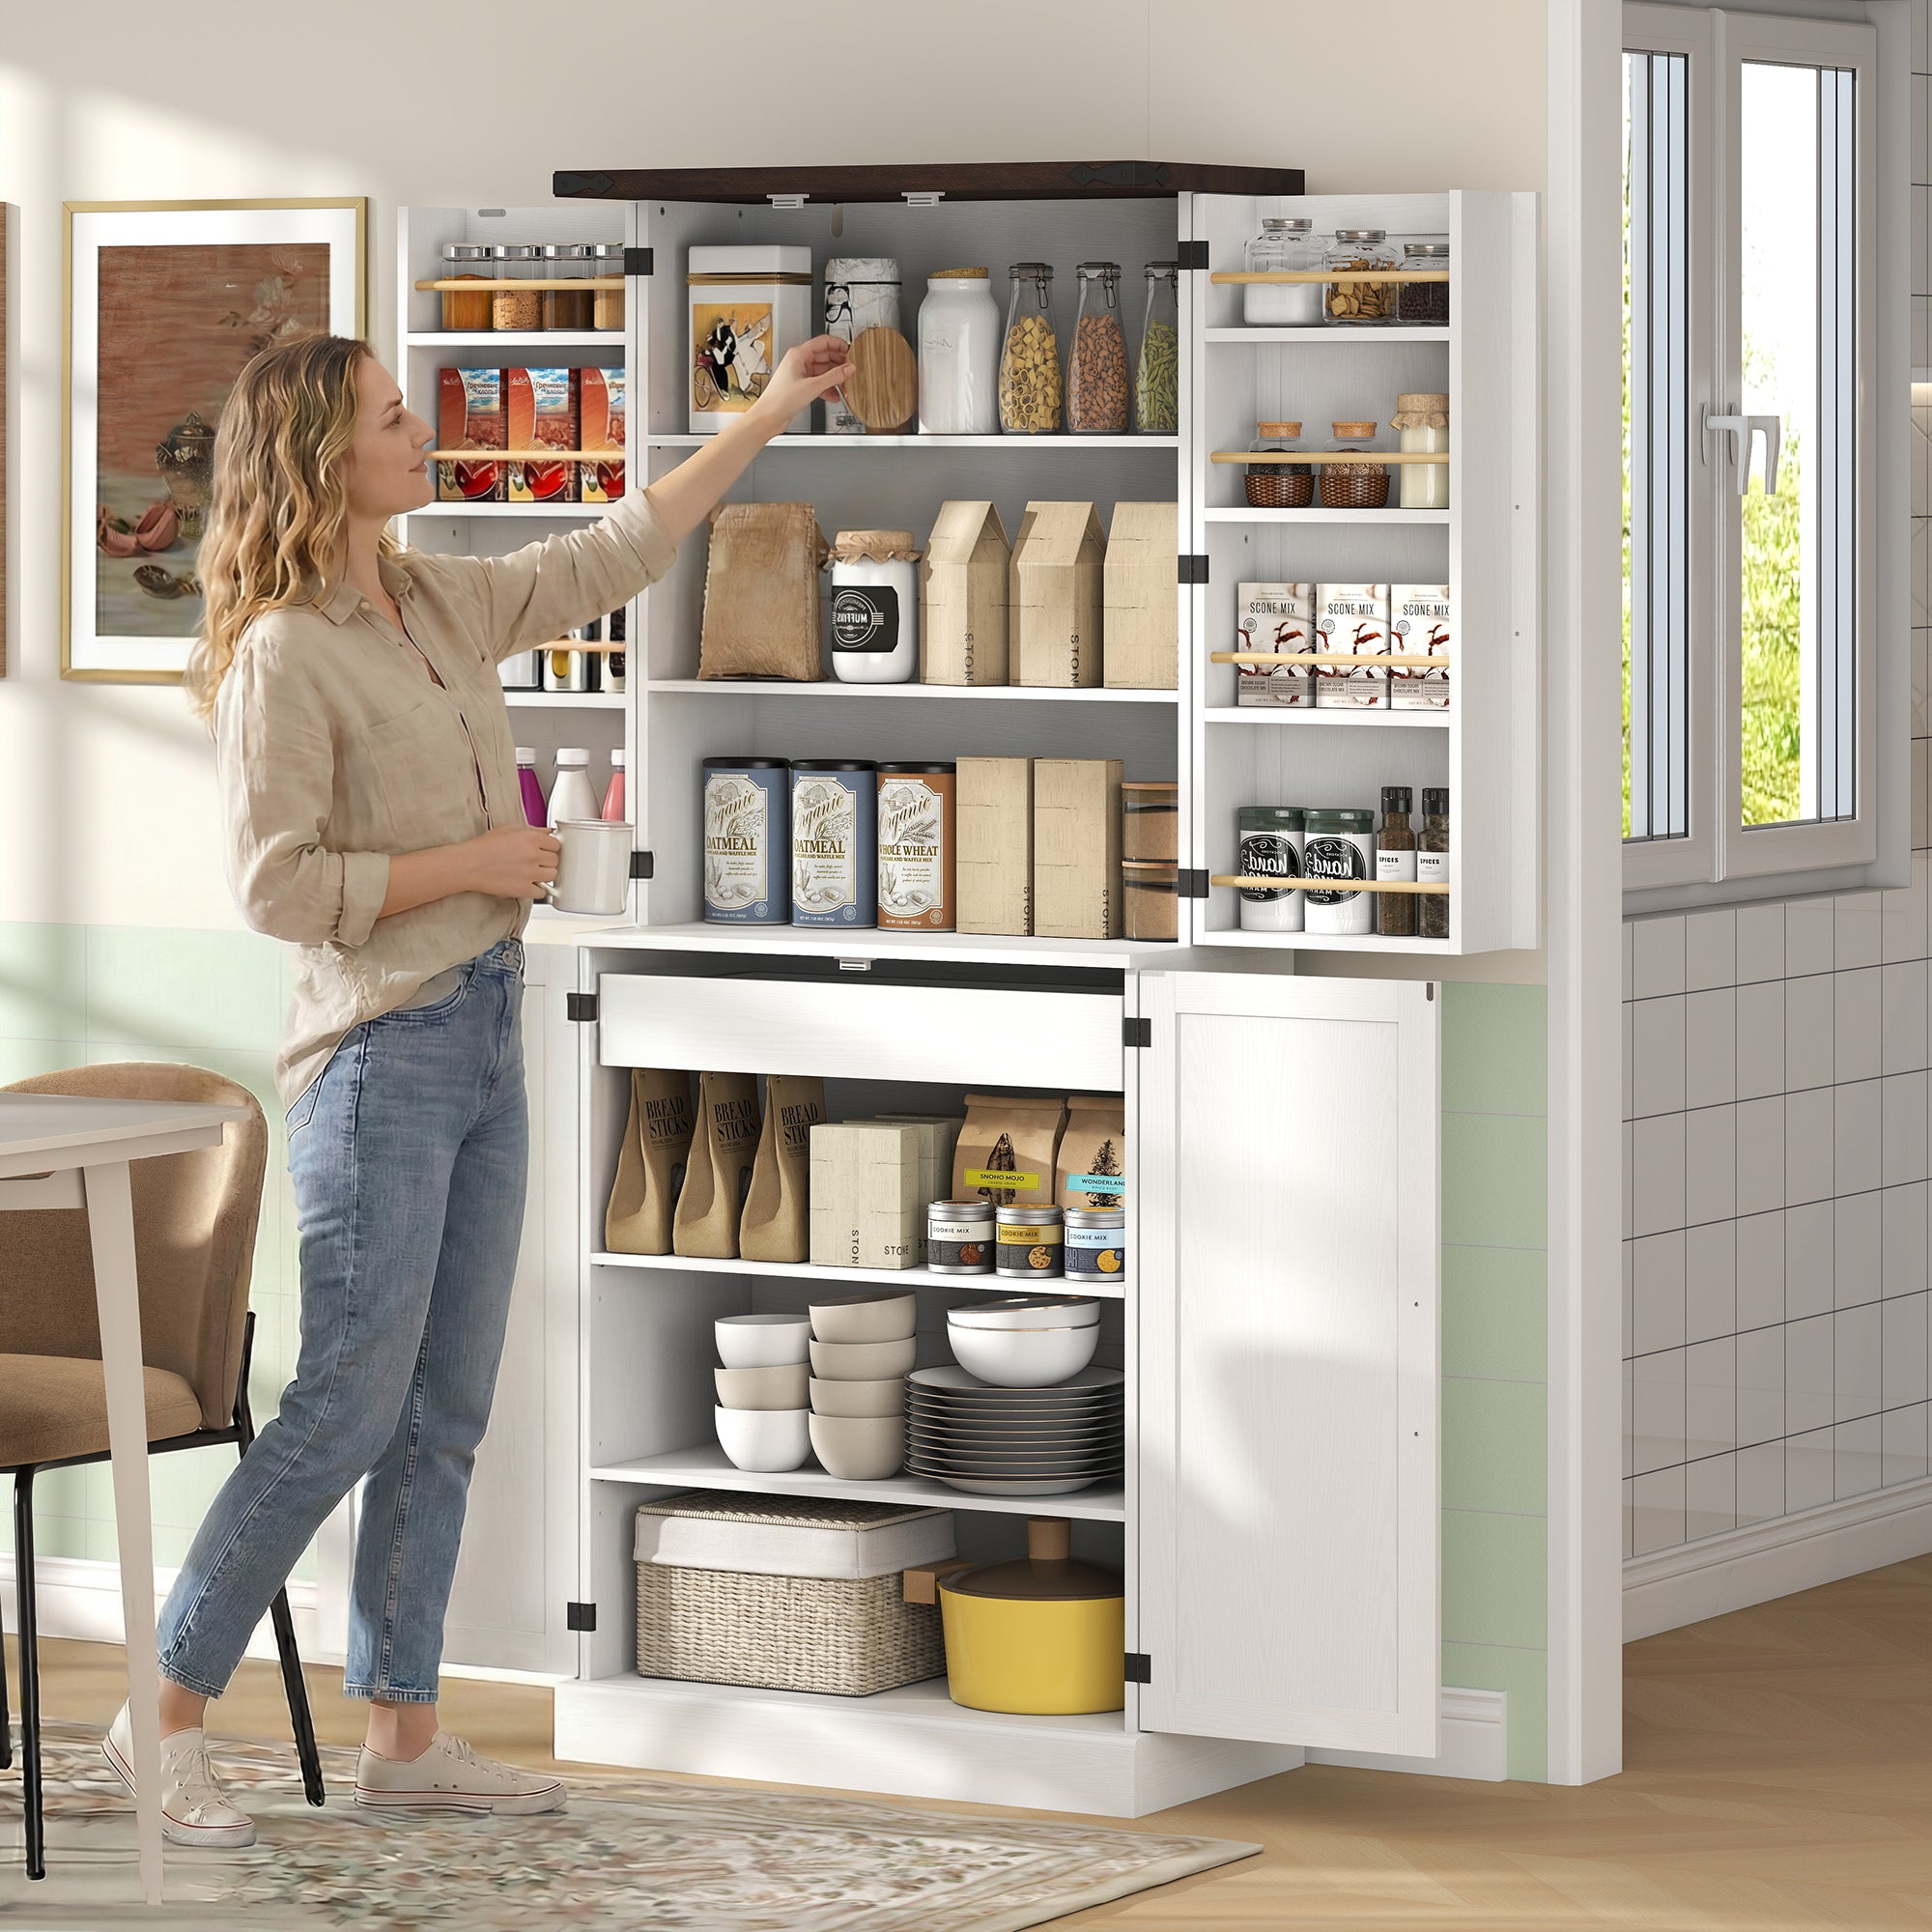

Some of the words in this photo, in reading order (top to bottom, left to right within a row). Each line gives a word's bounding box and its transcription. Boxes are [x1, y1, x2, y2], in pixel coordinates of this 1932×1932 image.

[1250, 602, 1277, 613] SCONE
[1280, 603, 1295, 613] MIX
[1327, 603, 1355, 614] SCONE
[1358, 604, 1375, 614] MIX
[1403, 604, 1431, 616] SCONE
[1434, 605, 1449, 616] MIX
[705, 790, 756, 837] Organic
[794, 792, 845, 839] Organic
[880, 795, 931, 841] Organic
[706, 836, 757, 851] OATMEAL
[794, 838, 846, 854] OATMEAL
[903, 845, 939, 856] WHEAT
[645, 1096, 684, 1120] BREAD
[714, 1099, 752, 1122] BREAD
[781, 1102, 818, 1126] BREAD
[649, 1115, 689, 1139] STICKS
[717, 1119, 756, 1142] STICKS
[784, 1122, 810, 1146] STIC
[851, 1229, 860, 1264] STON
[884, 1245, 909, 1256] STONE
